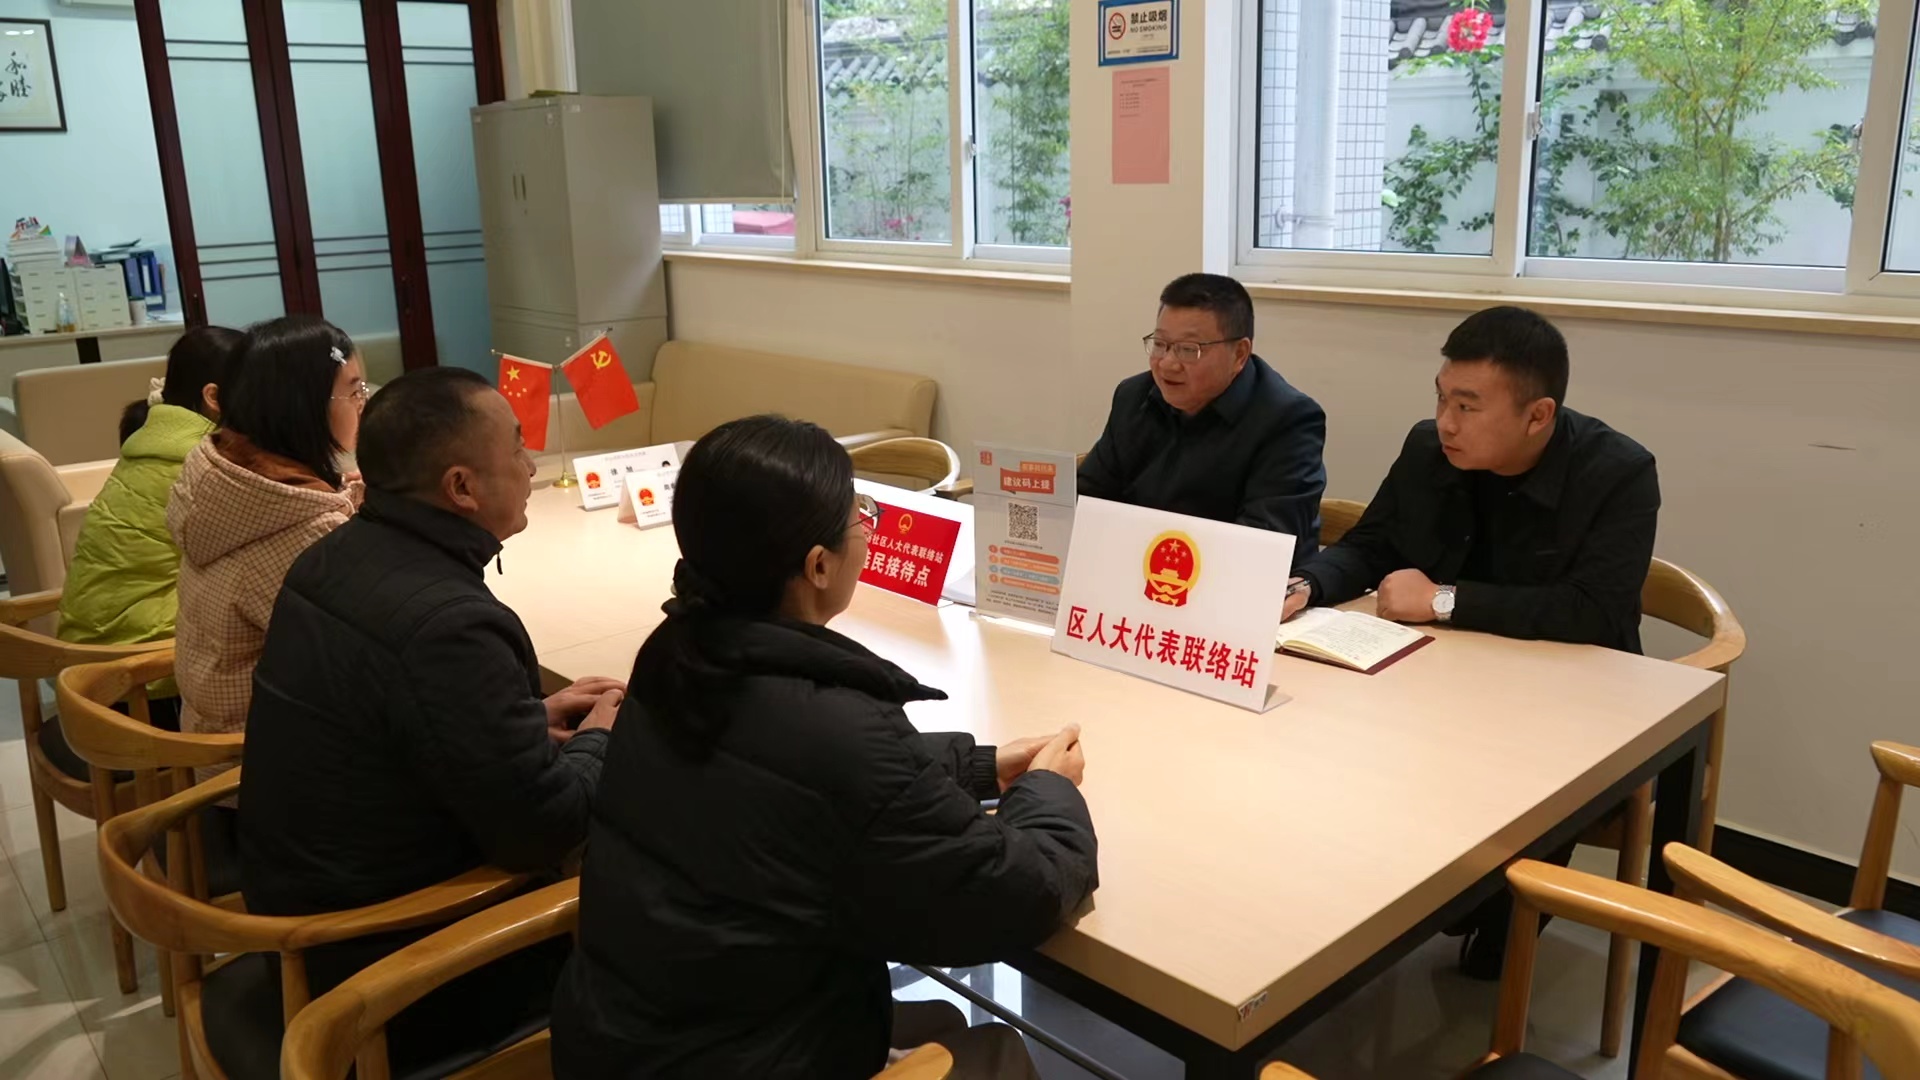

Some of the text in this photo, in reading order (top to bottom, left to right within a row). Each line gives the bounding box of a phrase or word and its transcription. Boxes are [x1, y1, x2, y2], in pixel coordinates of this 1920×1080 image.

[1131, 9, 1168, 24] 禁止吸烟
[1140, 24, 1168, 33] SMOKING
[1003, 476, 1051, 490] 建议码上提
[1066, 605, 1259, 689] 区人大代表联络站
